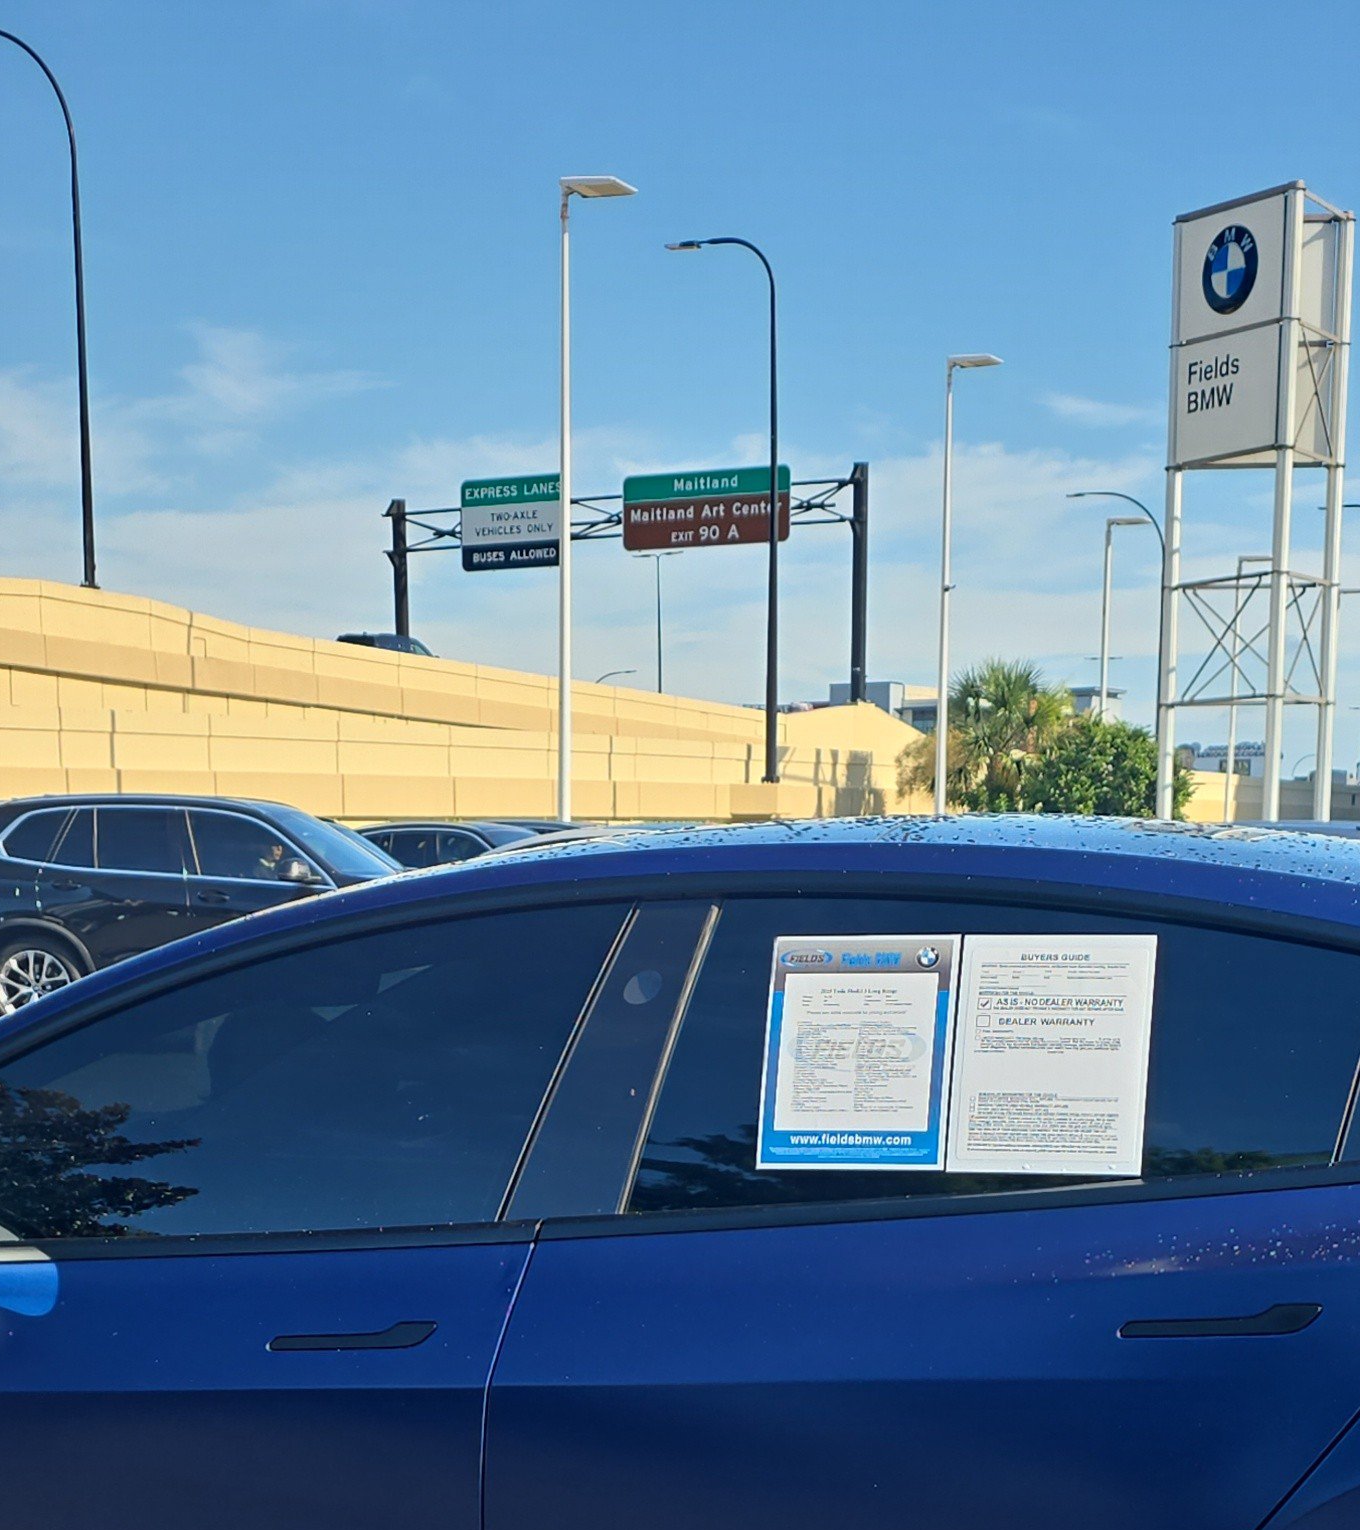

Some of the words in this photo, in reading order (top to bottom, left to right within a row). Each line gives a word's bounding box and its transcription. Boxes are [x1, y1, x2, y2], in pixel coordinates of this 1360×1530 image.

[1208, 227, 1253, 261] BMW
[1188, 353, 1240, 385] Fields
[1187, 382, 1234, 413] BMW
[465, 485, 518, 500] EXPRESS
[523, 481, 561, 495] LANES
[673, 474, 739, 492] Maitland
[630, 505, 694, 523] Maitland
[701, 503, 726, 519] Art
[474, 524, 522, 537] VEHICLES
[526, 522, 554, 533] ONLY
[671, 531, 695, 543] EXIT
[699, 525, 720, 540] 90
[727, 524, 740, 540] A
[472, 550, 506, 563] BUSES
[509, 547, 557, 560] ALLOWED
[790, 954, 825, 964] FIELDS
[1020, 953, 1059, 961] BUYERS
[1061, 953, 1091, 961] GUIDE
[996, 998, 1009, 1006] AS
[1010, 998, 1019, 1006] IS
[1024, 998, 1038, 1006] NO
[1039, 998, 1073, 1006] DEALER
[1074, 998, 1124, 1007] WARRANTY
[998, 1018, 1037, 1026] DEALER
[1040, 1018, 1096, 1027] WARRANTY
[789, 1133, 913, 1146] www.fieldsbmw.com
